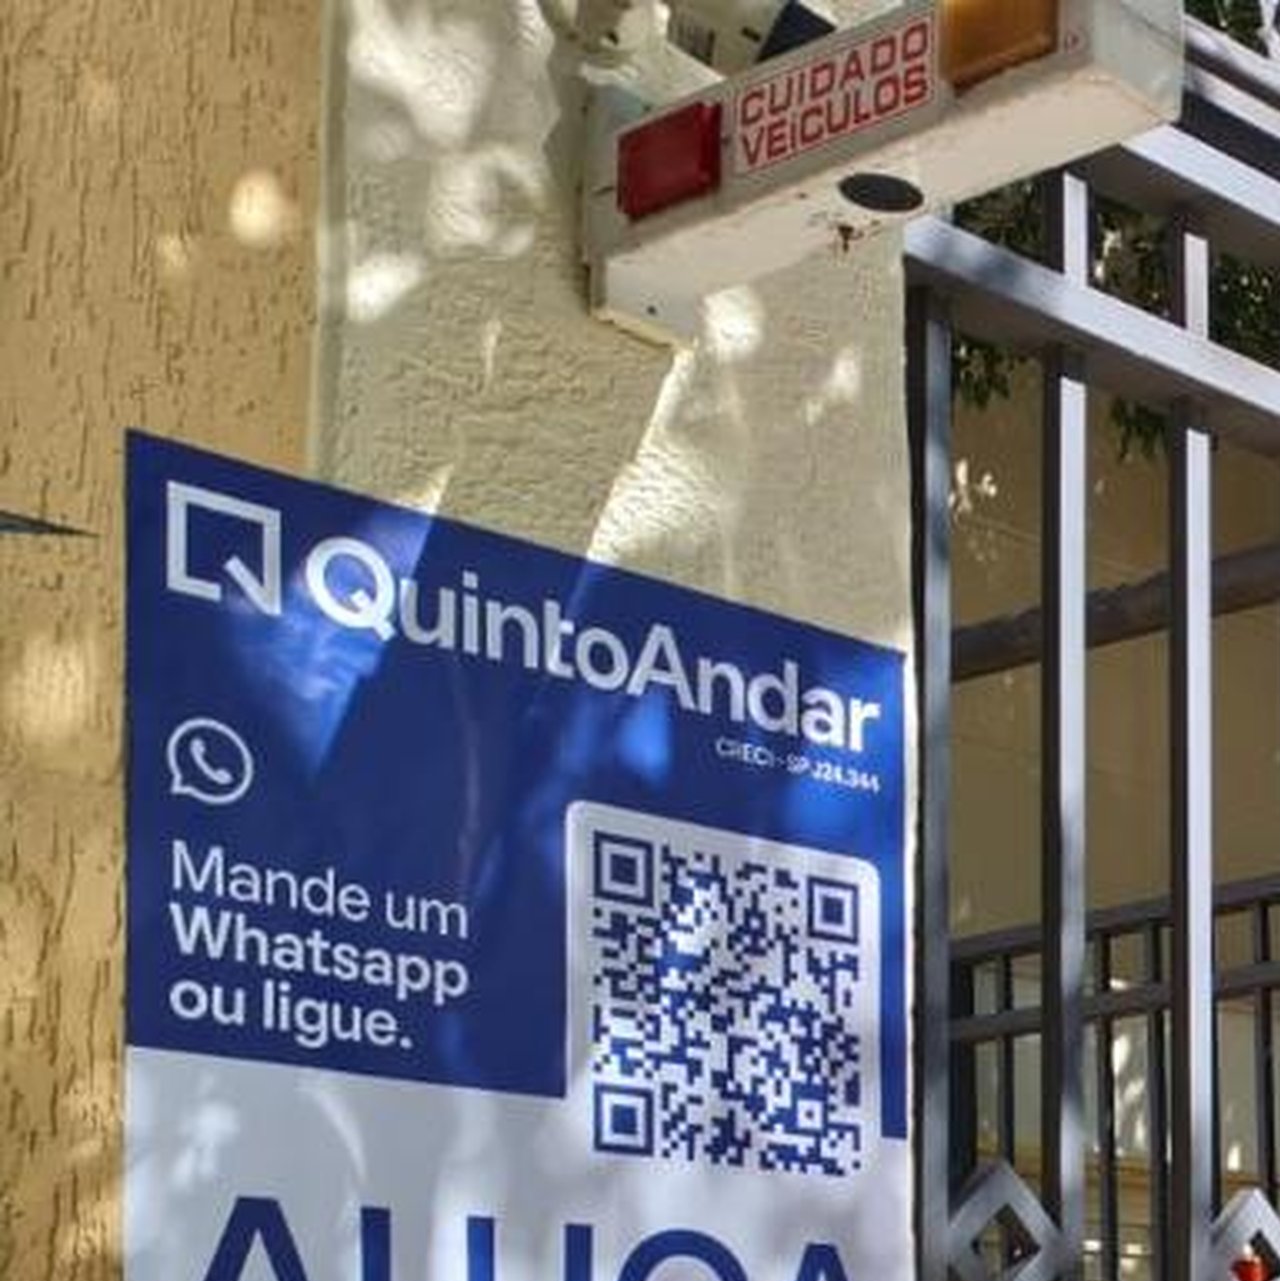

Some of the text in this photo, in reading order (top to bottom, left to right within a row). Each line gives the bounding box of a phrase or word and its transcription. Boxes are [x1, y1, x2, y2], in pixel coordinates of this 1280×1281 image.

[741, 21, 928, 125] CUIDADO
[304, 536, 880, 753] QuintoAndar
[172, 840, 468, 938] Mande um
[170, 903, 469, 1004] Whatsapp
[170, 979, 412, 1049] ou ligue.
